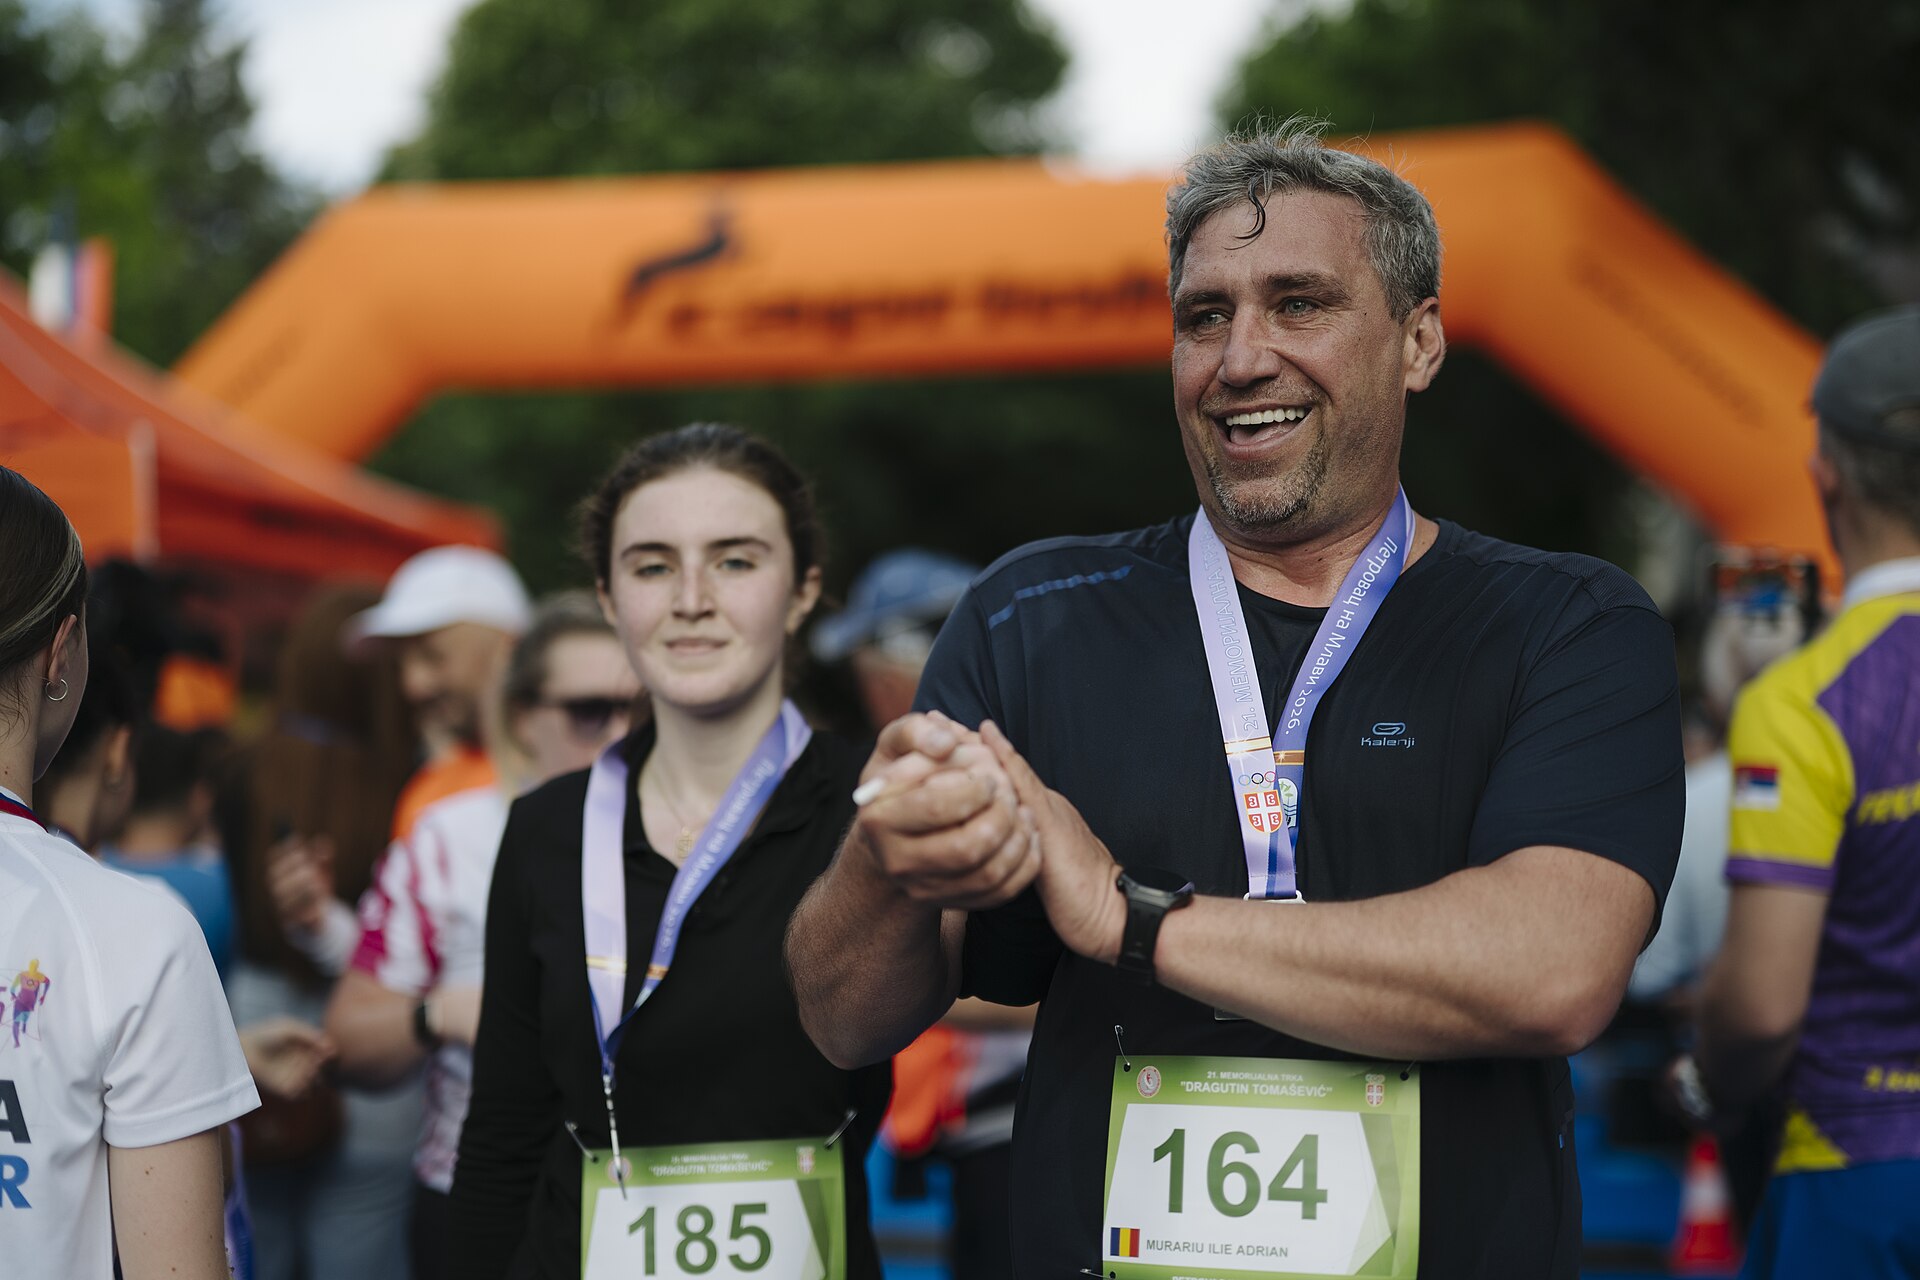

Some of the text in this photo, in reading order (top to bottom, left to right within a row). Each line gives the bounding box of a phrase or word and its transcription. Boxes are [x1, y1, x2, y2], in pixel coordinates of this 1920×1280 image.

[1285, 536, 1398, 735] Петровац на Млави 2026.
[1241, 706, 1258, 731] 21.
[1361, 737, 1415, 749] Kalenji
[1153, 1128, 1328, 1220] 164
[628, 1203, 772, 1276] 185
[1146, 1239, 1288, 1257] MURARIU ILIE ADRIAN
